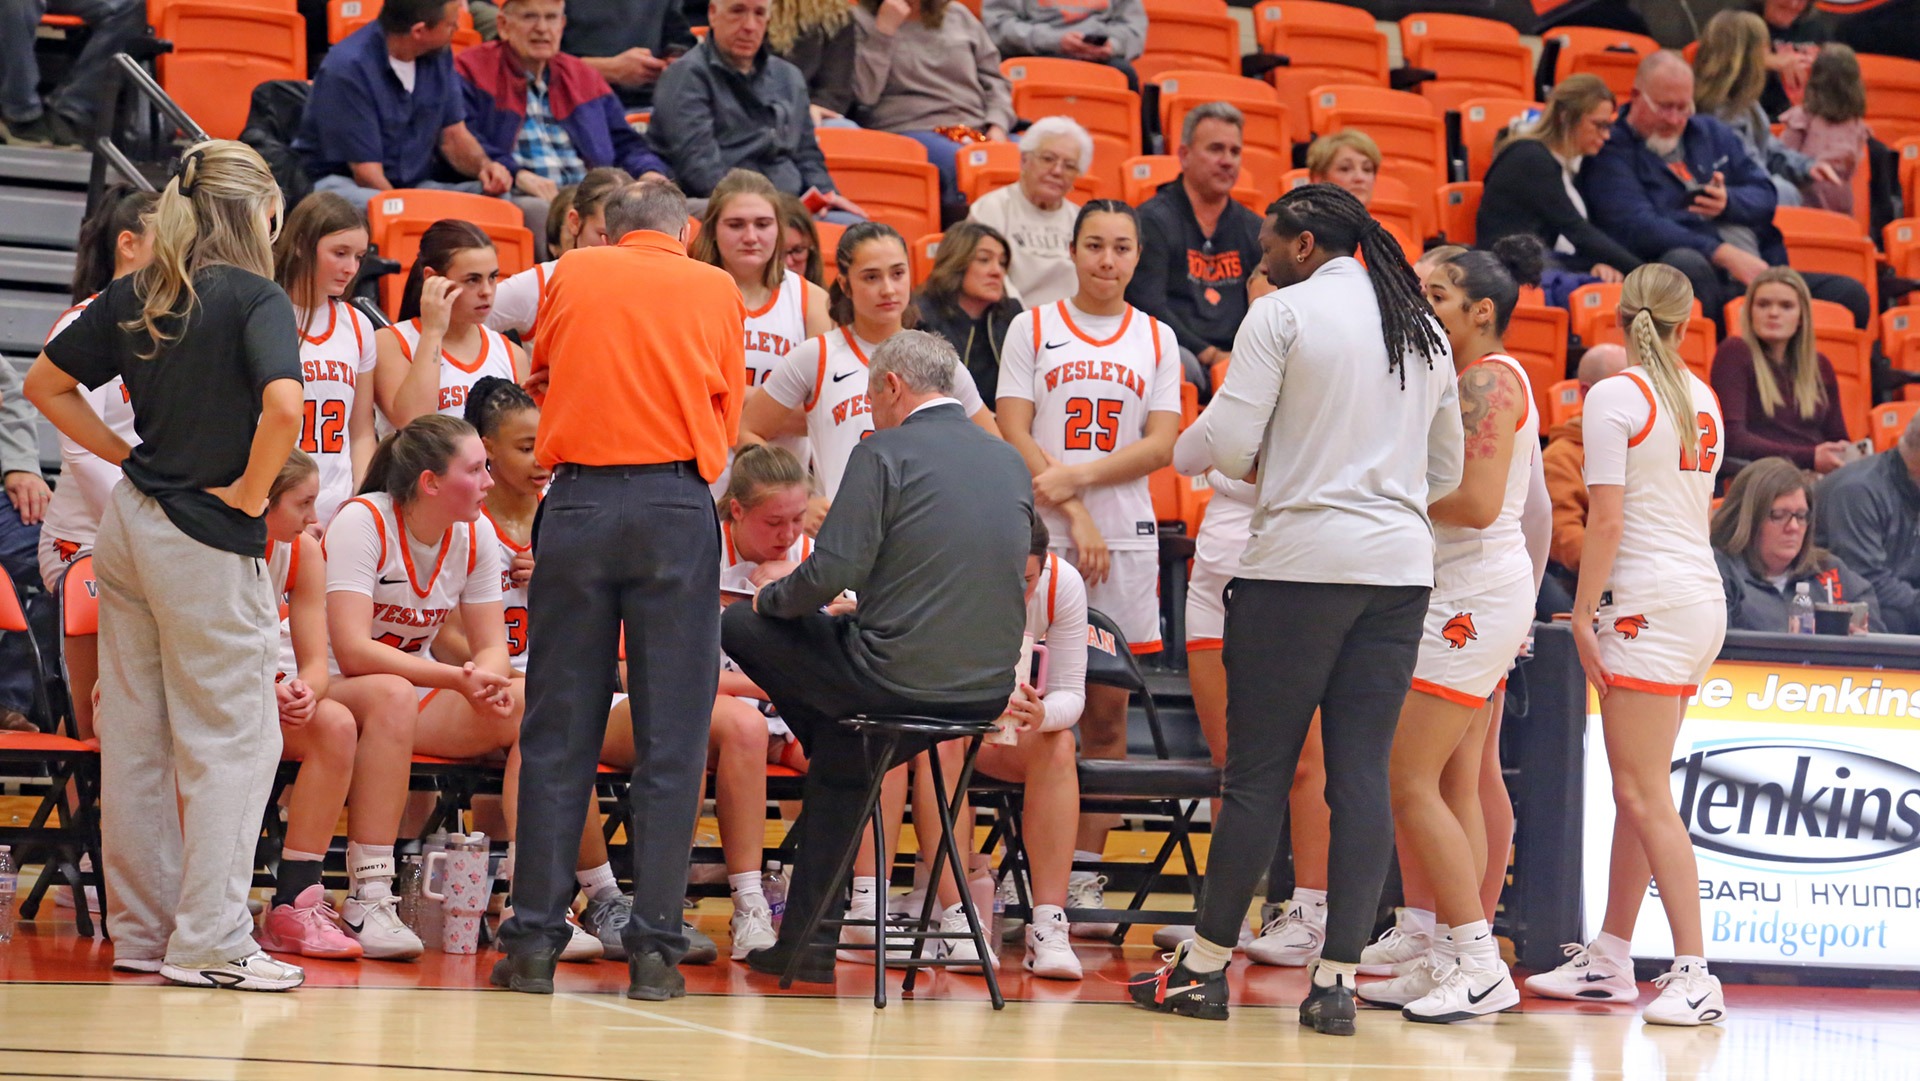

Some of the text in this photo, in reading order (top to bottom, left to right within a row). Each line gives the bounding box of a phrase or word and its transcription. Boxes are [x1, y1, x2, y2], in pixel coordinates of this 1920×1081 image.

[1045, 361, 1146, 400] WESLEYAN
[299, 399, 346, 453] 12
[1065, 397, 1124, 452] 25
[1680, 750, 1920, 844] Jenkins
[1811, 883, 1920, 909] HYUND
[1711, 909, 1888, 957] Bridgeport
